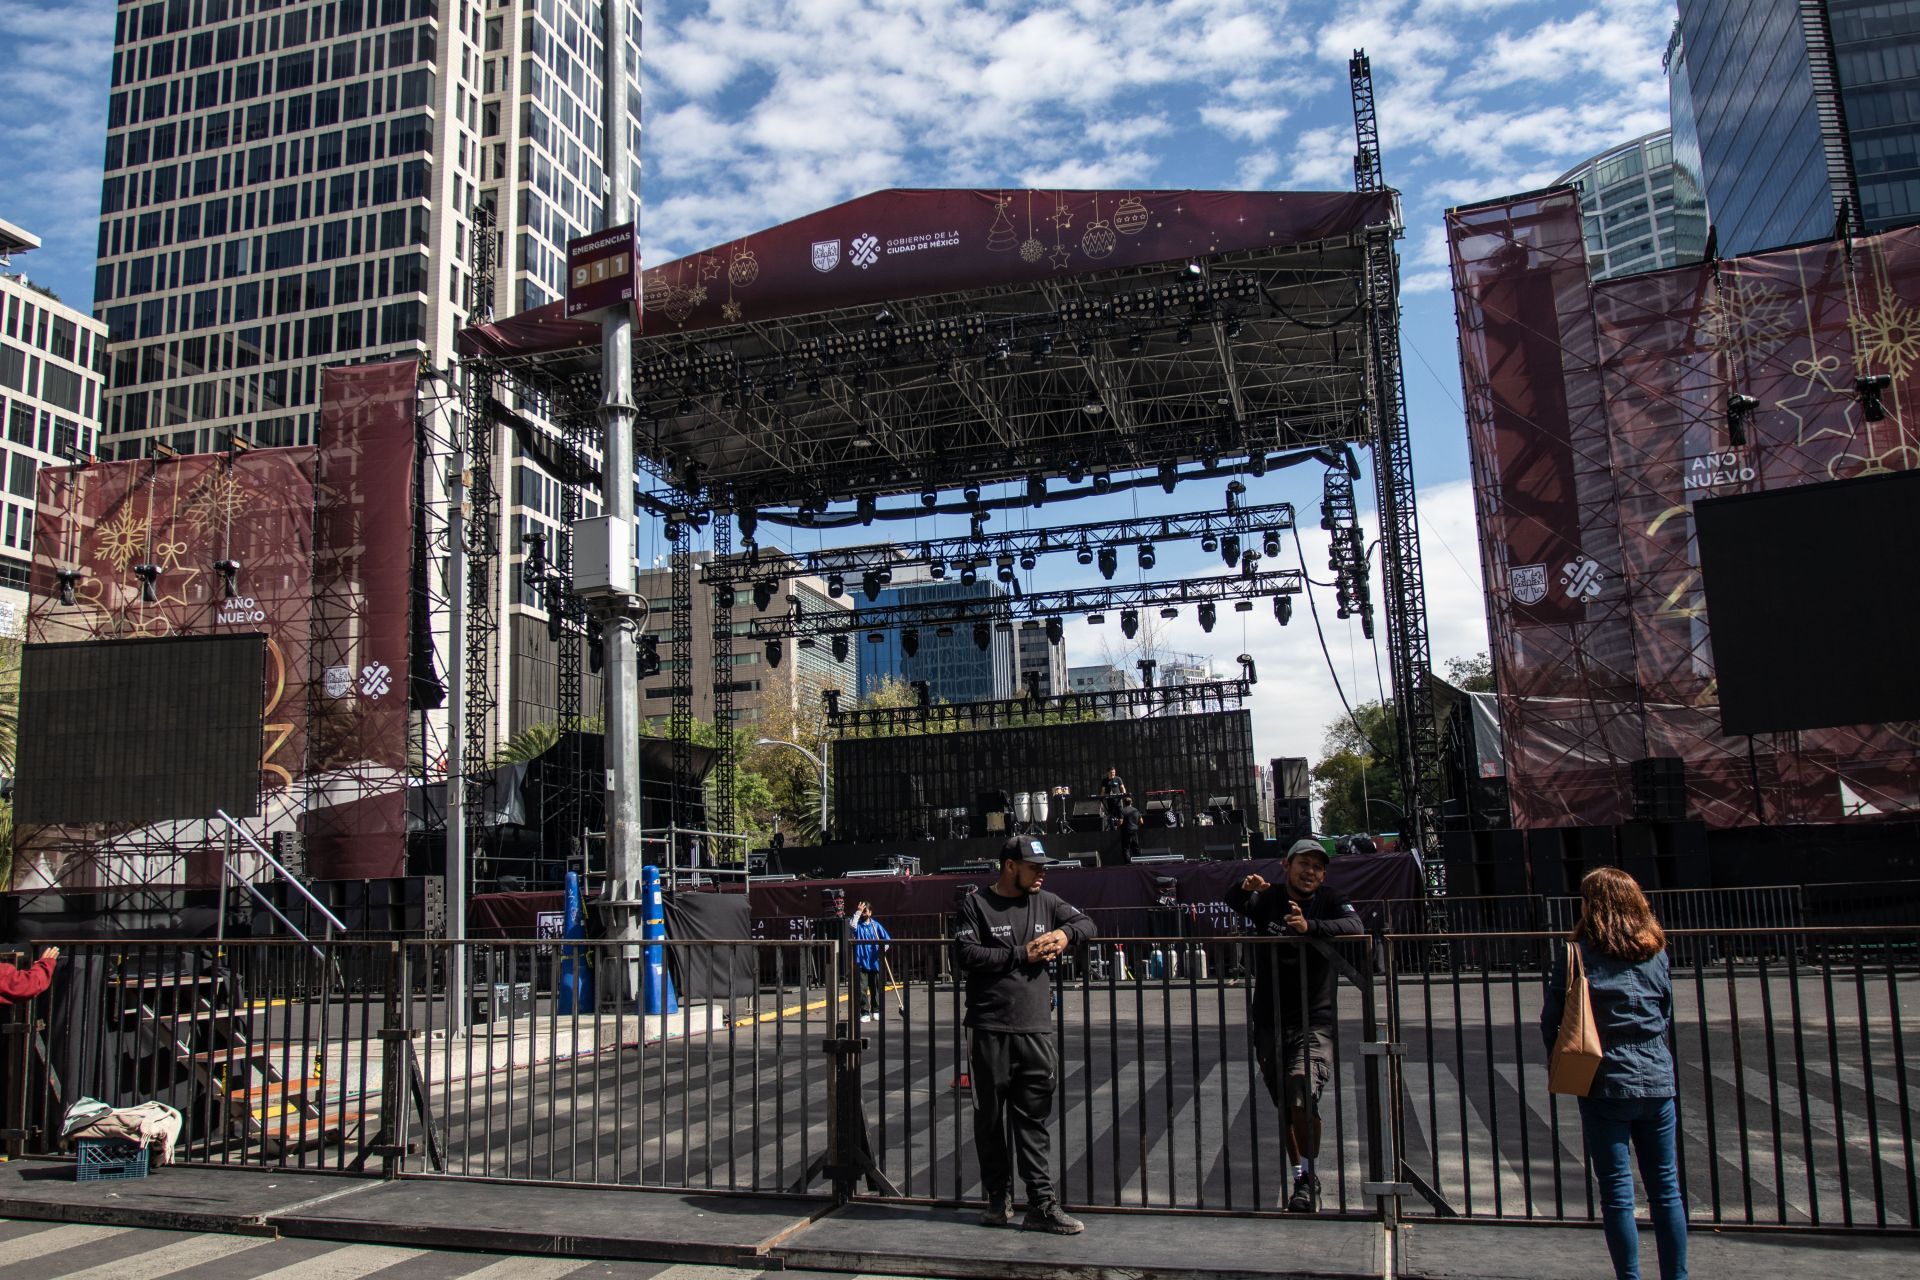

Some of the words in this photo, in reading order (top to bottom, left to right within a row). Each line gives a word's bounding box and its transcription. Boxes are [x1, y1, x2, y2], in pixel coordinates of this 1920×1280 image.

[572, 232, 631, 256] EMERGENCIAS
[886, 244, 916, 254] CIUDAD
[917, 242, 929, 250] DE
[930, 238, 960, 248] MÉXICO
[887, 234, 932, 247] GOBIERNO
[934, 231, 946, 240] DE
[948, 230, 960, 238] LA
[576, 257, 623, 284] 911
[1691, 451, 1737, 470] AÑO
[1683, 467, 1756, 489] NUEVO
[224, 596, 255, 610] AÑO
[217, 611, 265, 624] NUEVO
